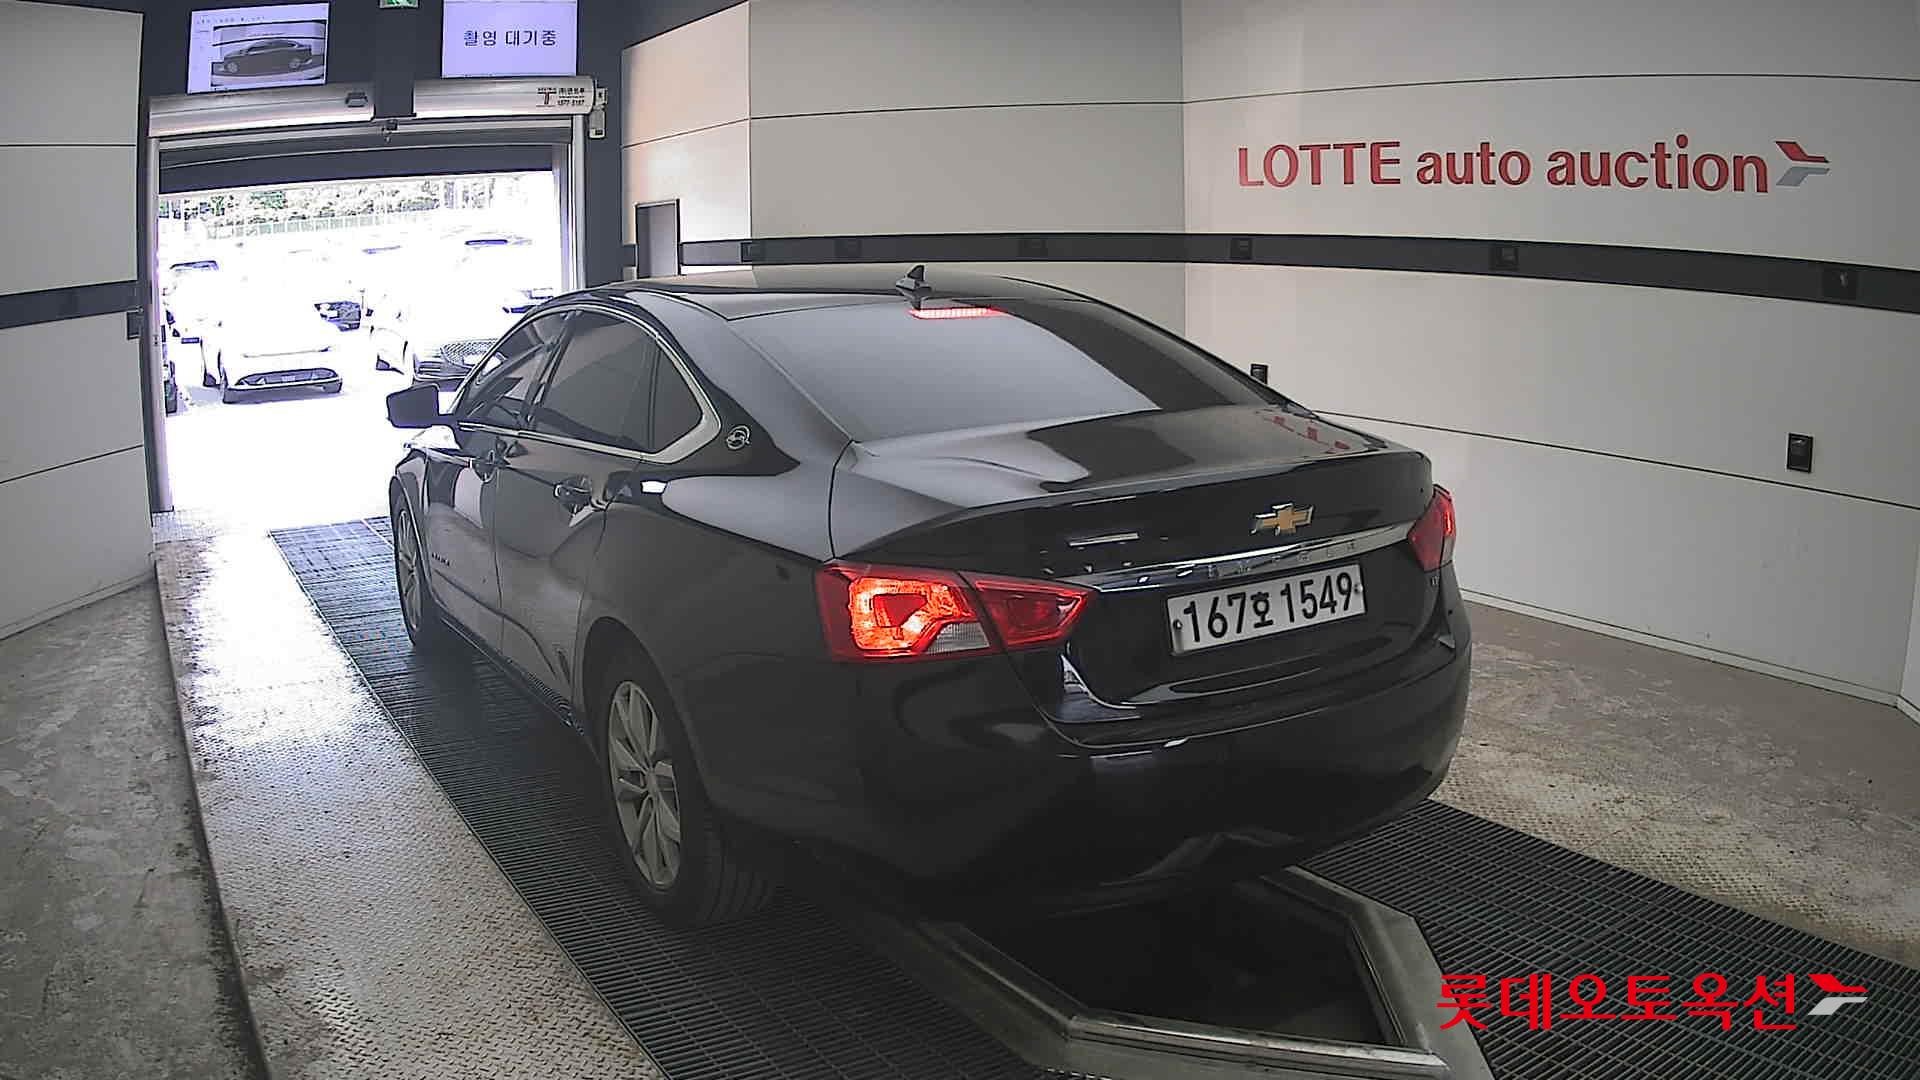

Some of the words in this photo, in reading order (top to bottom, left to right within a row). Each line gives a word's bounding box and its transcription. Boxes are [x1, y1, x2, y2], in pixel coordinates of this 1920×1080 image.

[505, 29, 557, 47] 대기중
[1238, 141, 1401, 187] LOTTE
[1416, 141, 1531, 186] auto
[1546, 134, 1769, 193] auction
[1183, 591, 1274, 643] 167호
[1280, 572, 1353, 624] 1549
